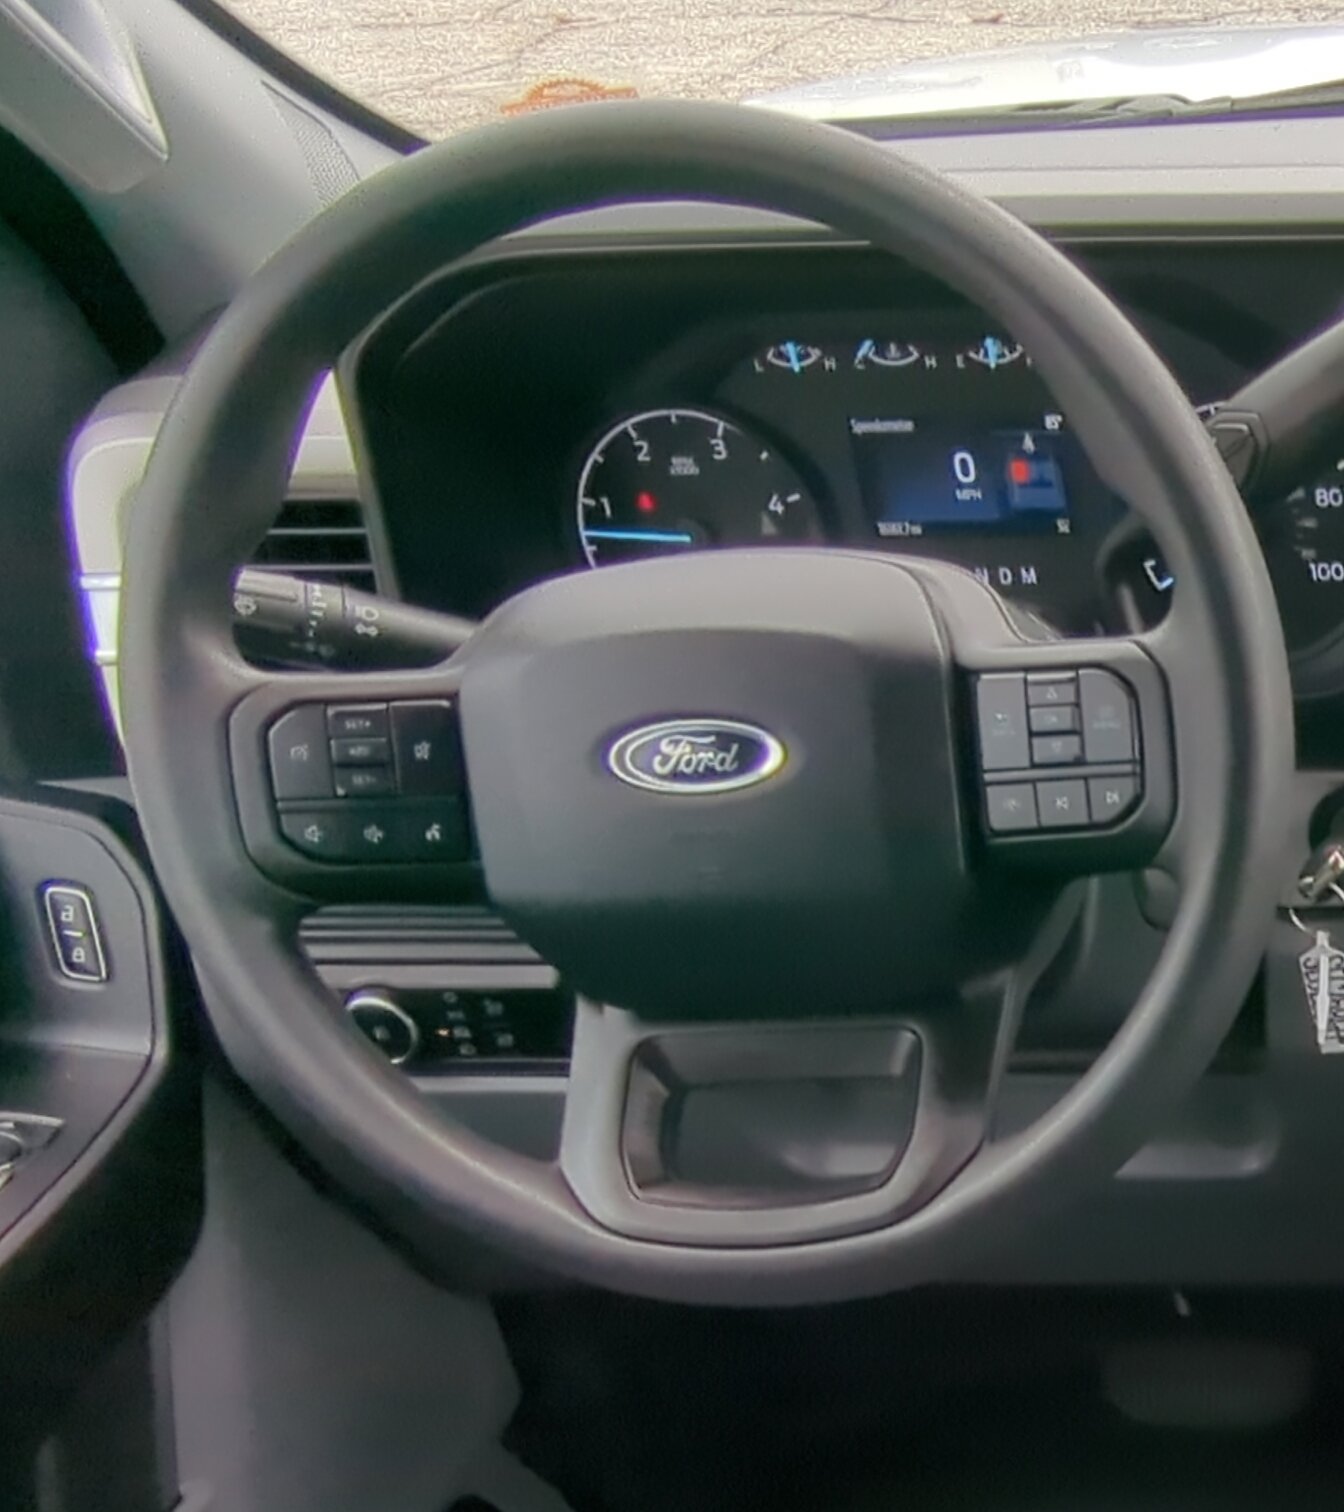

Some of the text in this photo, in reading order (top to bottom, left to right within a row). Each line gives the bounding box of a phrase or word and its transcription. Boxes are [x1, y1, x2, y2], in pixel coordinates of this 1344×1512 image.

[824, 359, 836, 371] H
[924, 356, 937, 369] H
[956, 356, 966, 369] E
[634, 441, 651, 462] 2
[711, 438, 728, 460] 3
[953, 451, 976, 484] 0
[768, 494, 785, 515] 4
[955, 488, 982, 501] MPH
[1314, 487, 1344, 508] 80
[600, 497, 612, 519] 1
[999, 567, 1012, 585] D
[1020, 566, 1038, 585] M
[652, 734, 739, 776] Ford
